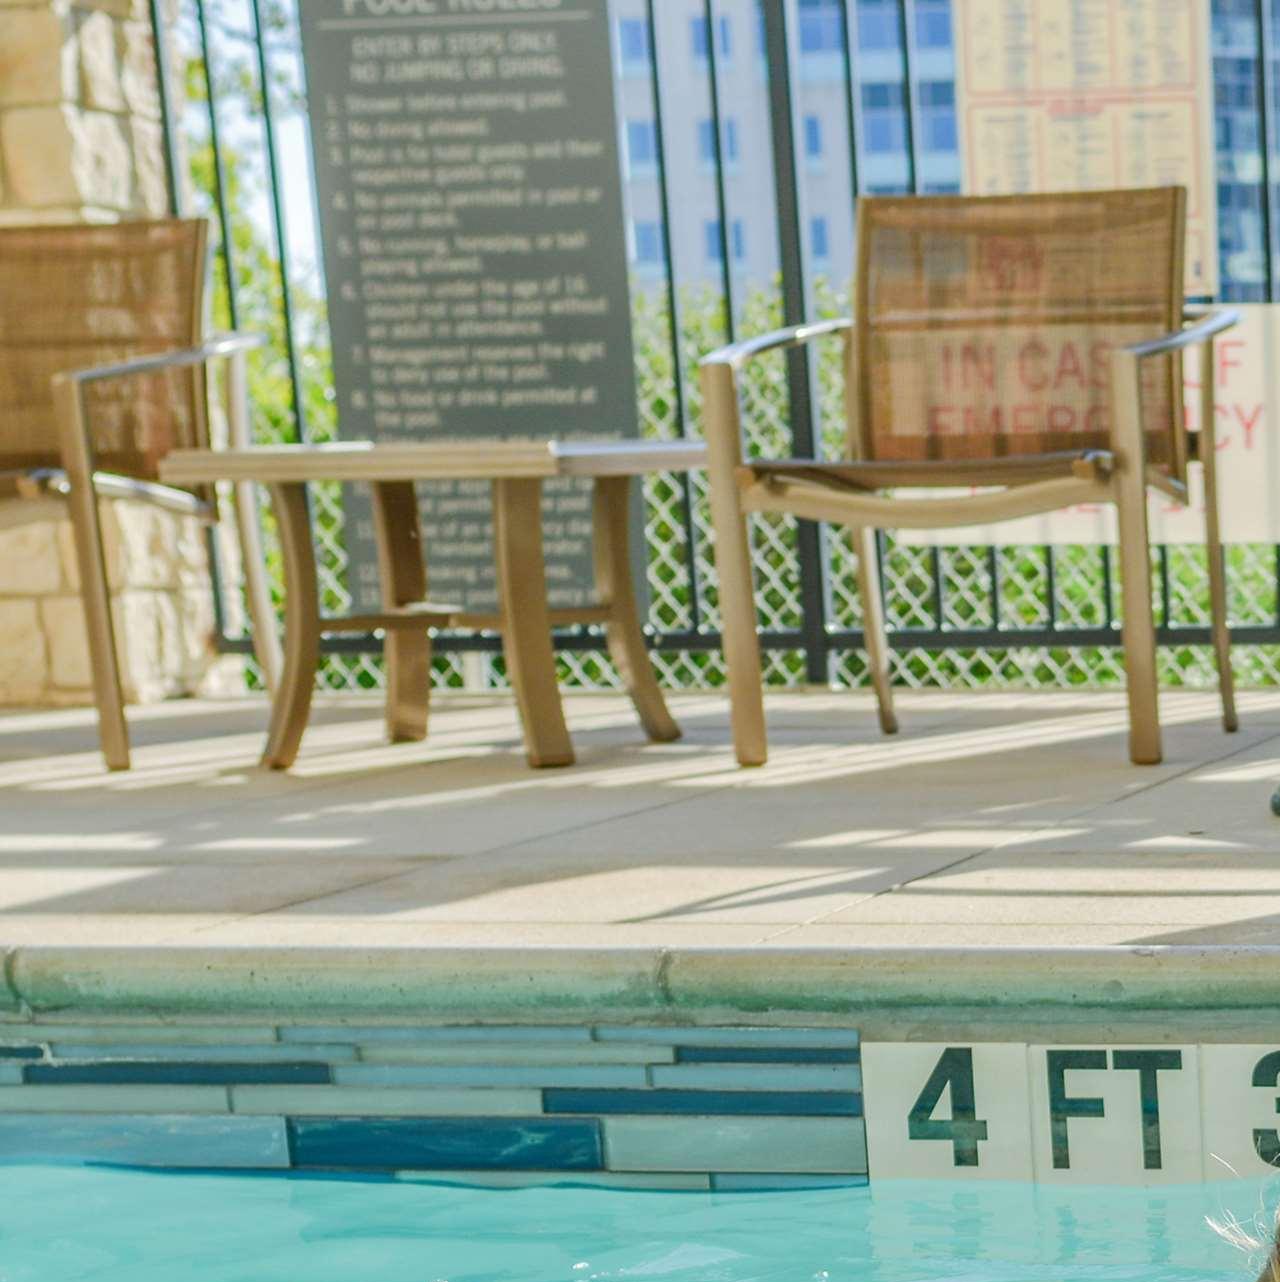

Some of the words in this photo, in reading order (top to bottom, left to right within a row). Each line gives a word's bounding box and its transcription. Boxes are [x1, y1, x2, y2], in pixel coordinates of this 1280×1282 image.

[941, 343, 995, 392] IN
[907, 1047, 988, 1167] 4
[1047, 1049, 1183, 1169] FT
